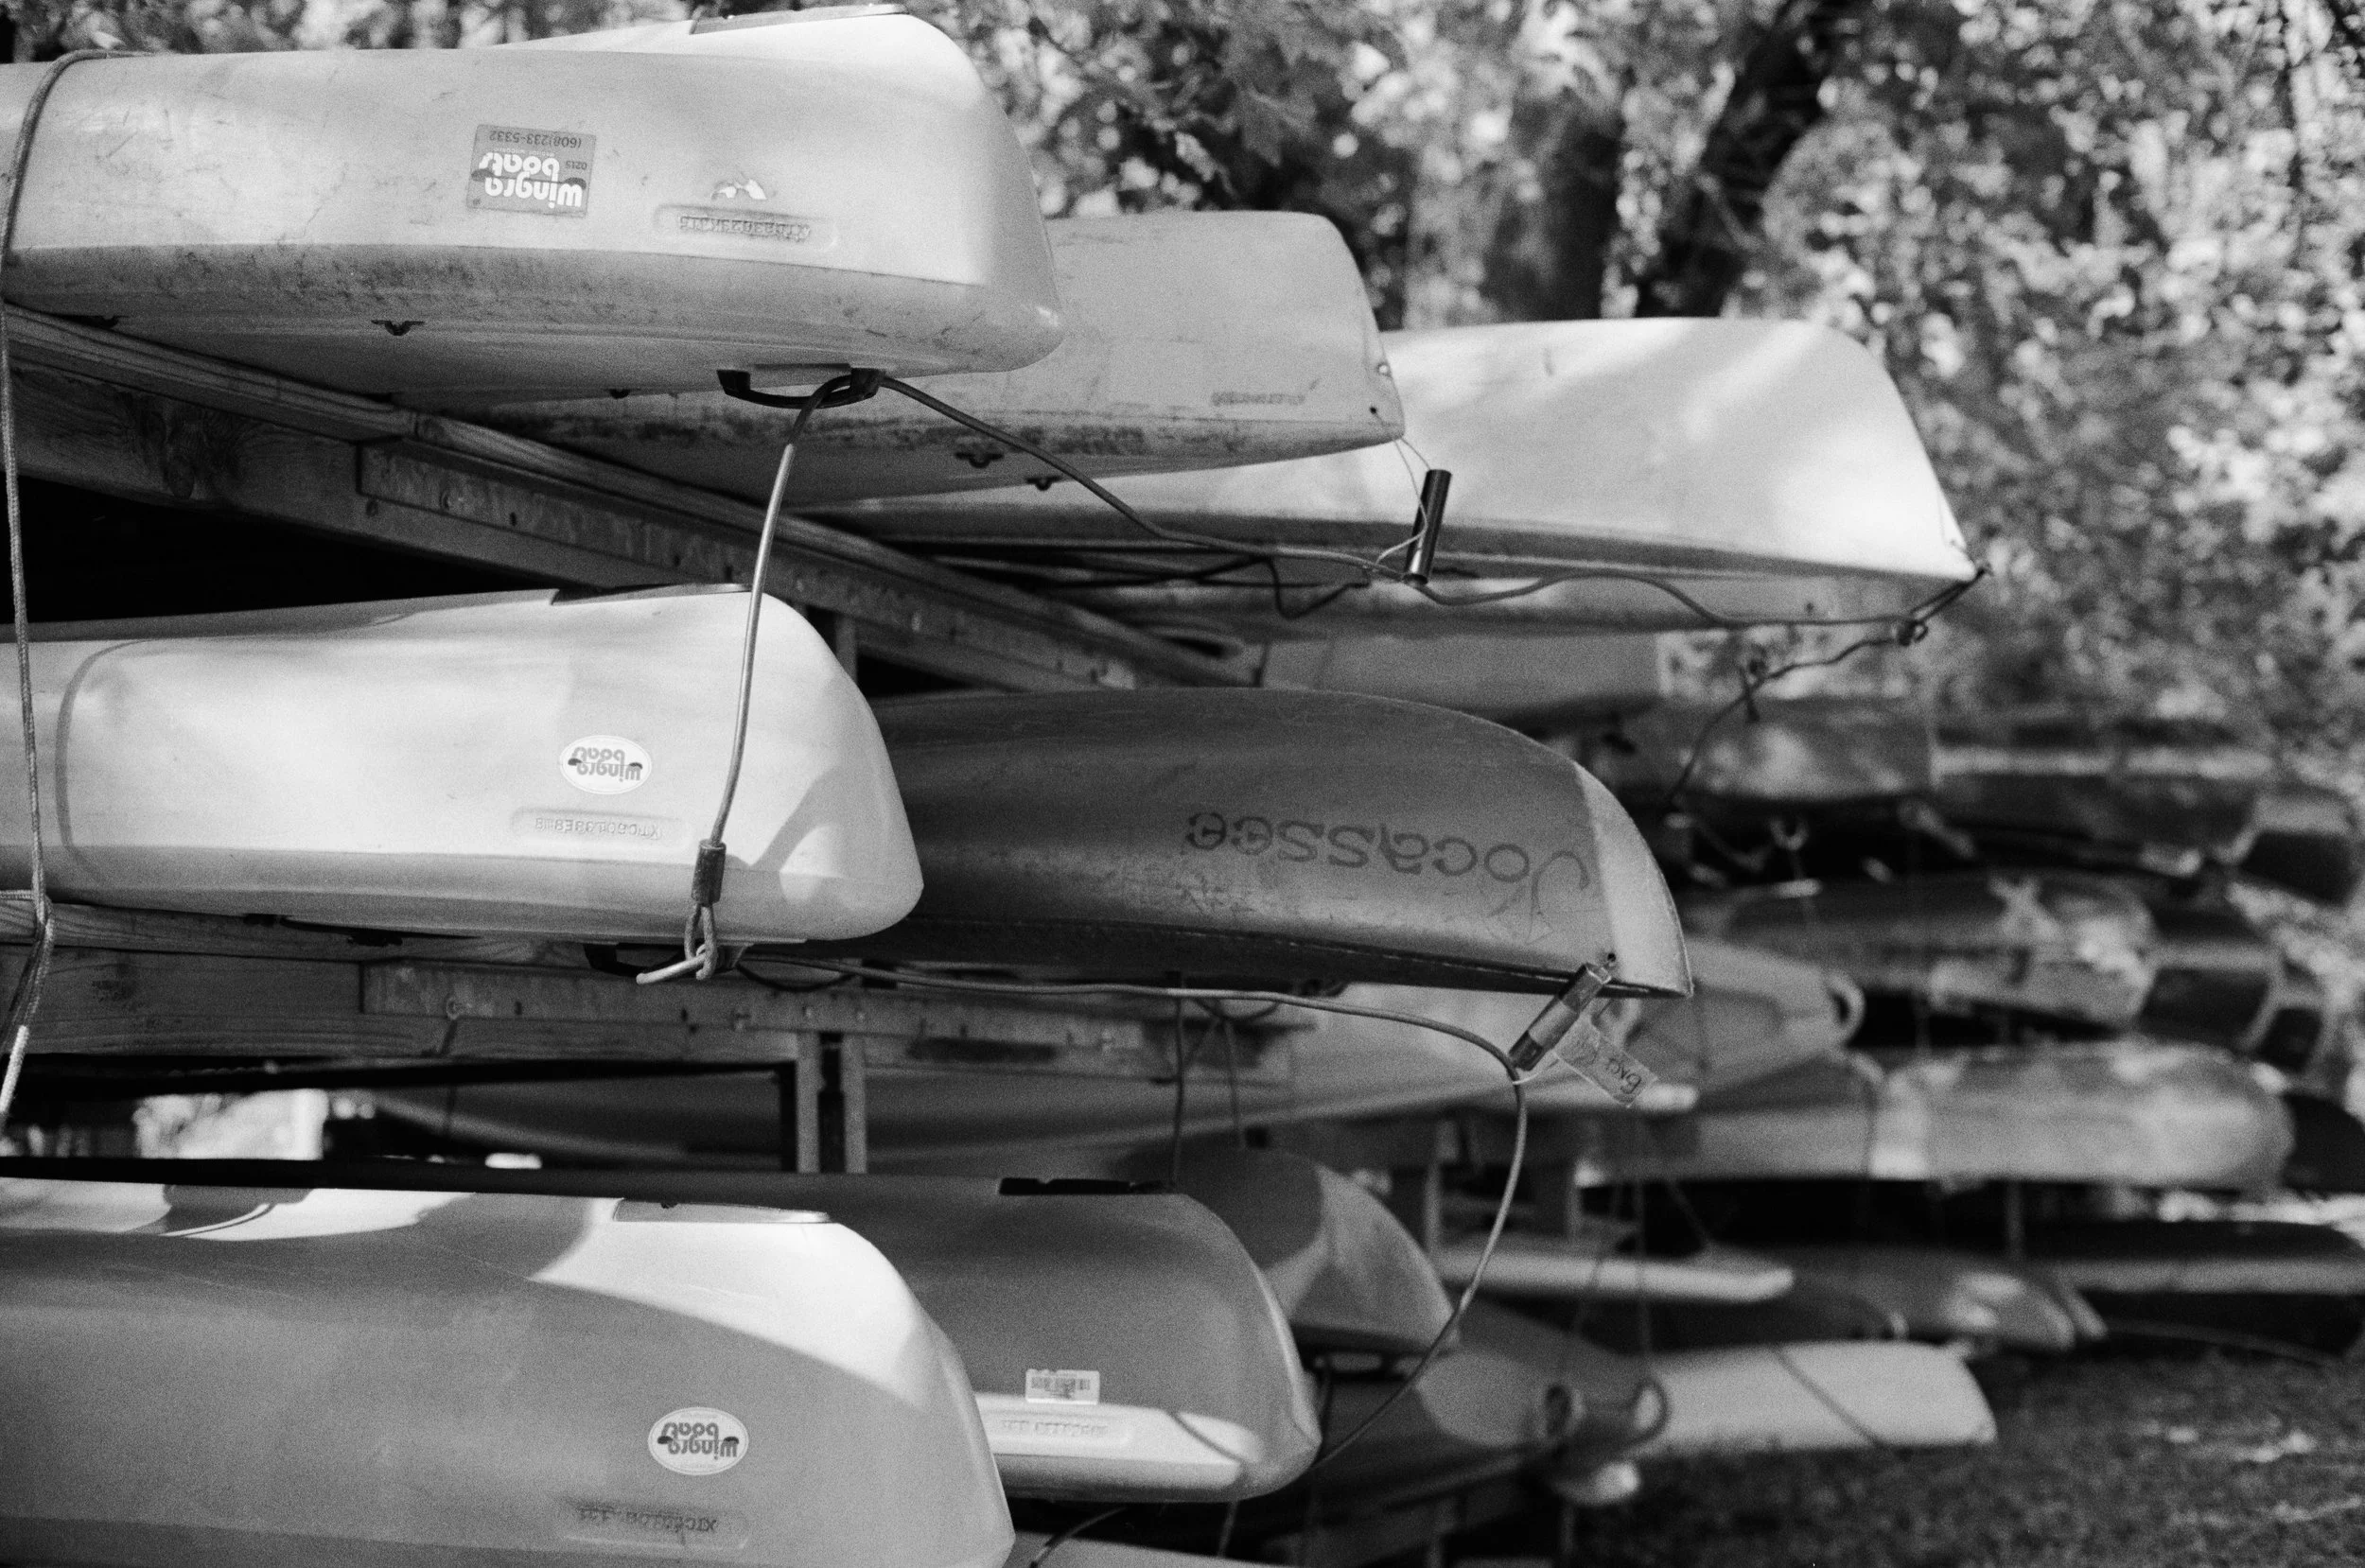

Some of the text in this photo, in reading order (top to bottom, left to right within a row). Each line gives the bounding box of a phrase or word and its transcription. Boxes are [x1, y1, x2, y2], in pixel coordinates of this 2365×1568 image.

[479, 151, 560, 183] boats
[484, 171, 583, 209] wingra
[571, 746, 625, 765] boats
[576, 759, 640, 782] wingra
[1185, 811, 1590, 946] Jocassee
[662, 1421, 719, 1440] boats
[667, 1435, 738, 1459] wingra
